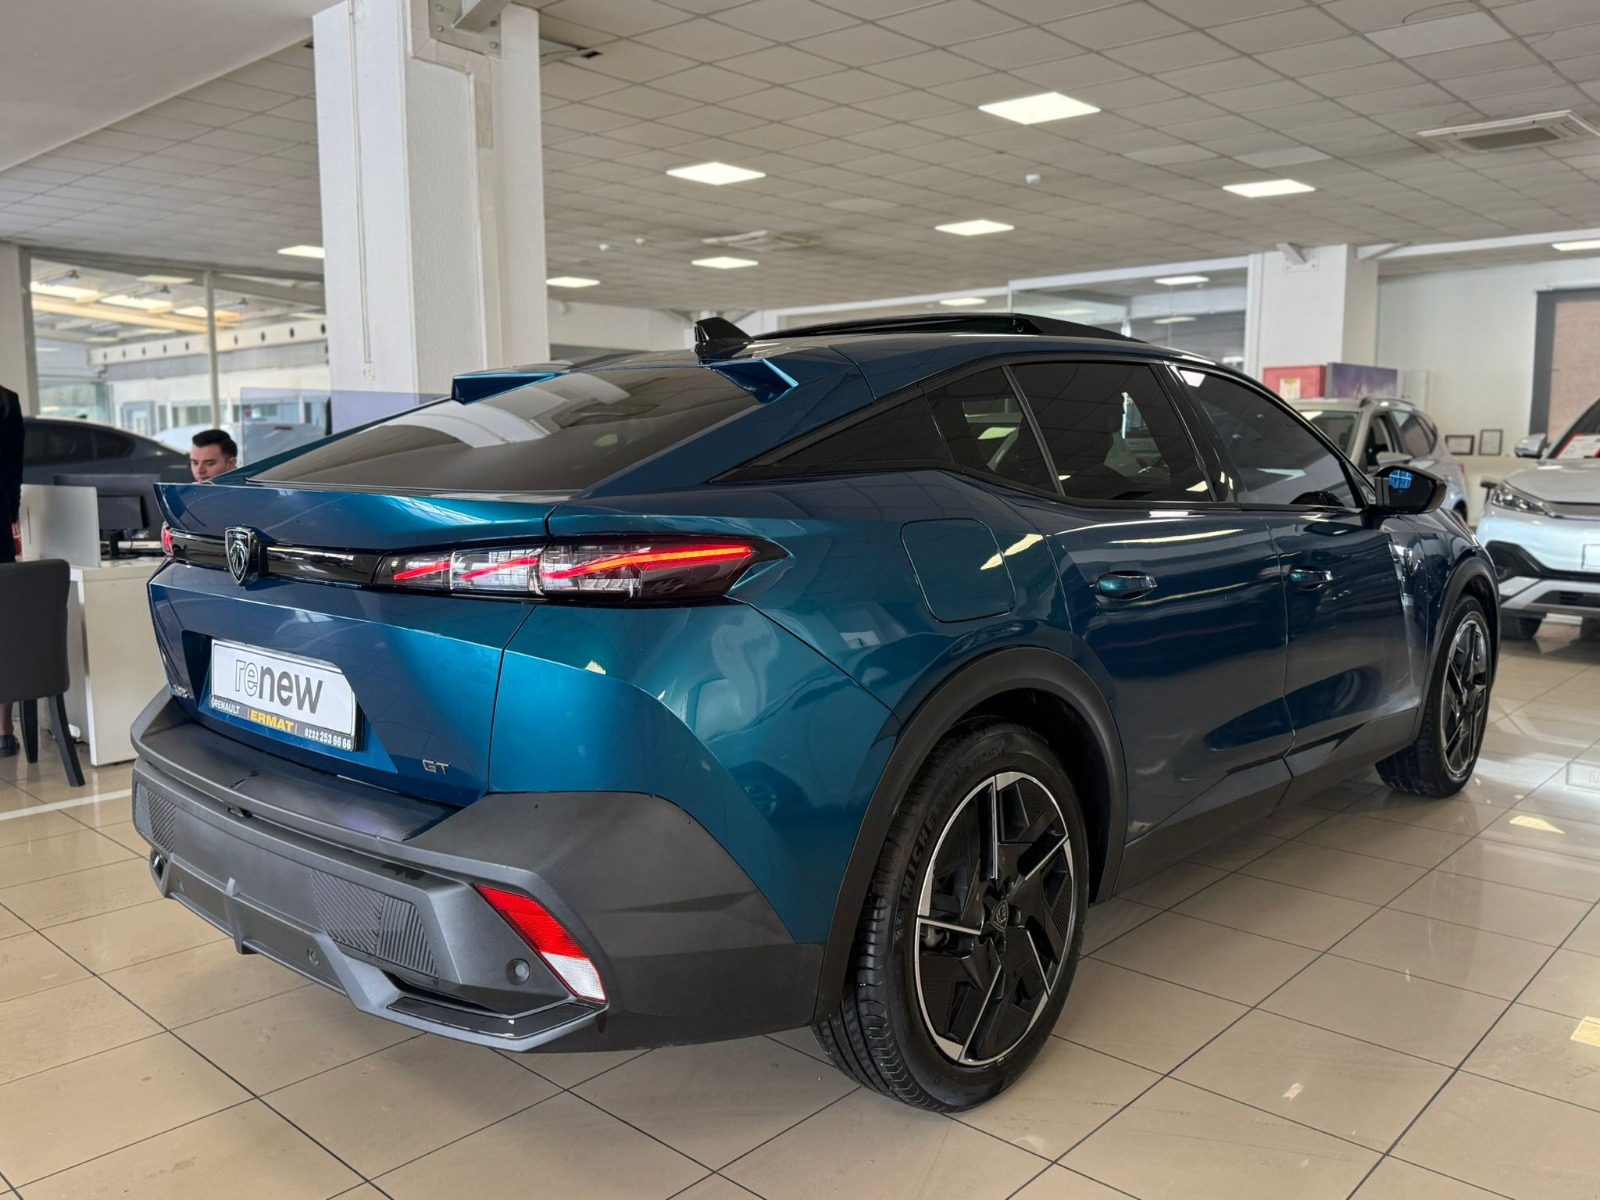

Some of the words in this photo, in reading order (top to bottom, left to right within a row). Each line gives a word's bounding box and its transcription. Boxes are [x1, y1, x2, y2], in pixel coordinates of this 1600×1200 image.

[235, 659, 323, 714] renew
[214, 699, 240, 714] RENAULT
[251, 709, 294, 732] ERMAT
[320, 732, 332, 744] 253
[422, 759, 451, 776] GT
